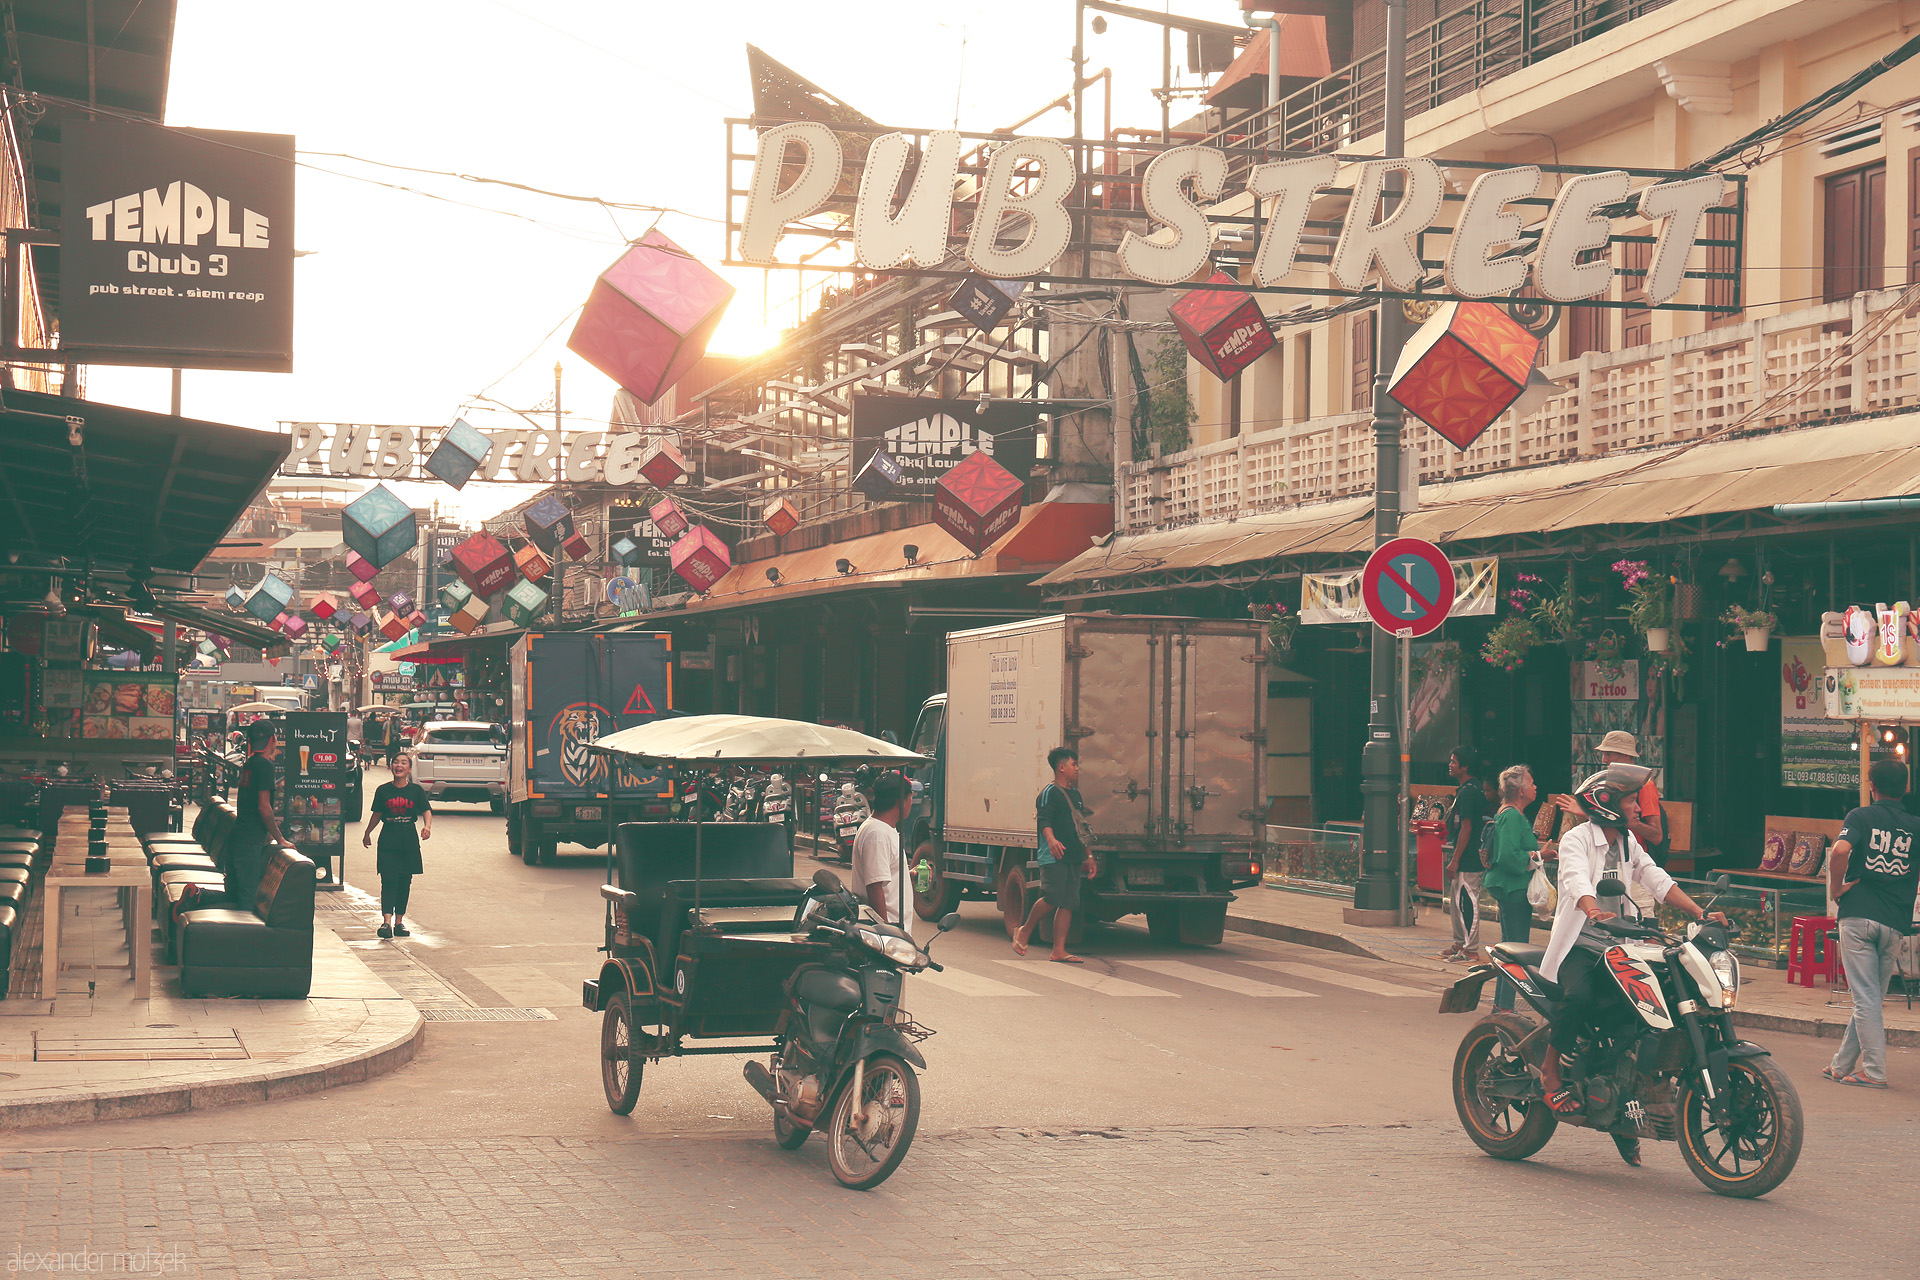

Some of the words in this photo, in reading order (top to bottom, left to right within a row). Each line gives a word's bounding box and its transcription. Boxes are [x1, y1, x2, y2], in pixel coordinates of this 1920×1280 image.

[86, 180, 270, 248] TEMPLE
[738, 121, 1076, 278] PUB
[1117, 145, 1726, 307] STREET
[127, 250, 200, 276] Club
[208, 254, 228, 277] 3
[90, 283, 119, 296] pub
[122, 284, 174, 297] street
[187, 287, 225, 300] siem
[229, 291, 265, 303] reap
[1217, 322, 1263, 359] TEMPLE
[884, 412, 994, 456] TEMPLE
[284, 422, 415, 477] PUB
[895, 455, 924, 470] Sky
[937, 502, 975, 535] TEMPLE
[984, 505, 1018, 536] TEMPLE
[481, 566, 510, 587] TEMPLE
[689, 559, 715, 582] TEMPLE
[1590, 682, 1627, 696] Tattoo
[1862, 699, 1882, 707] Welcome
[1883, 699, 1896, 707] Fried
[1783, 771, 1797, 781] TEL:
[1797, 772, 1808, 782] 093
[1809, 772, 1817, 781] 47
[1817, 773, 1825, 782] 88
[1826, 773, 1834, 783] 85
[1838, 774, 1850, 784] 093
[1851, 774, 1860, 784] 46
[1869, 828, 1914, 858] 대선
[1606, 946, 1663, 1009] DUKE
[1552, 1090, 1570, 1103] ADDA
